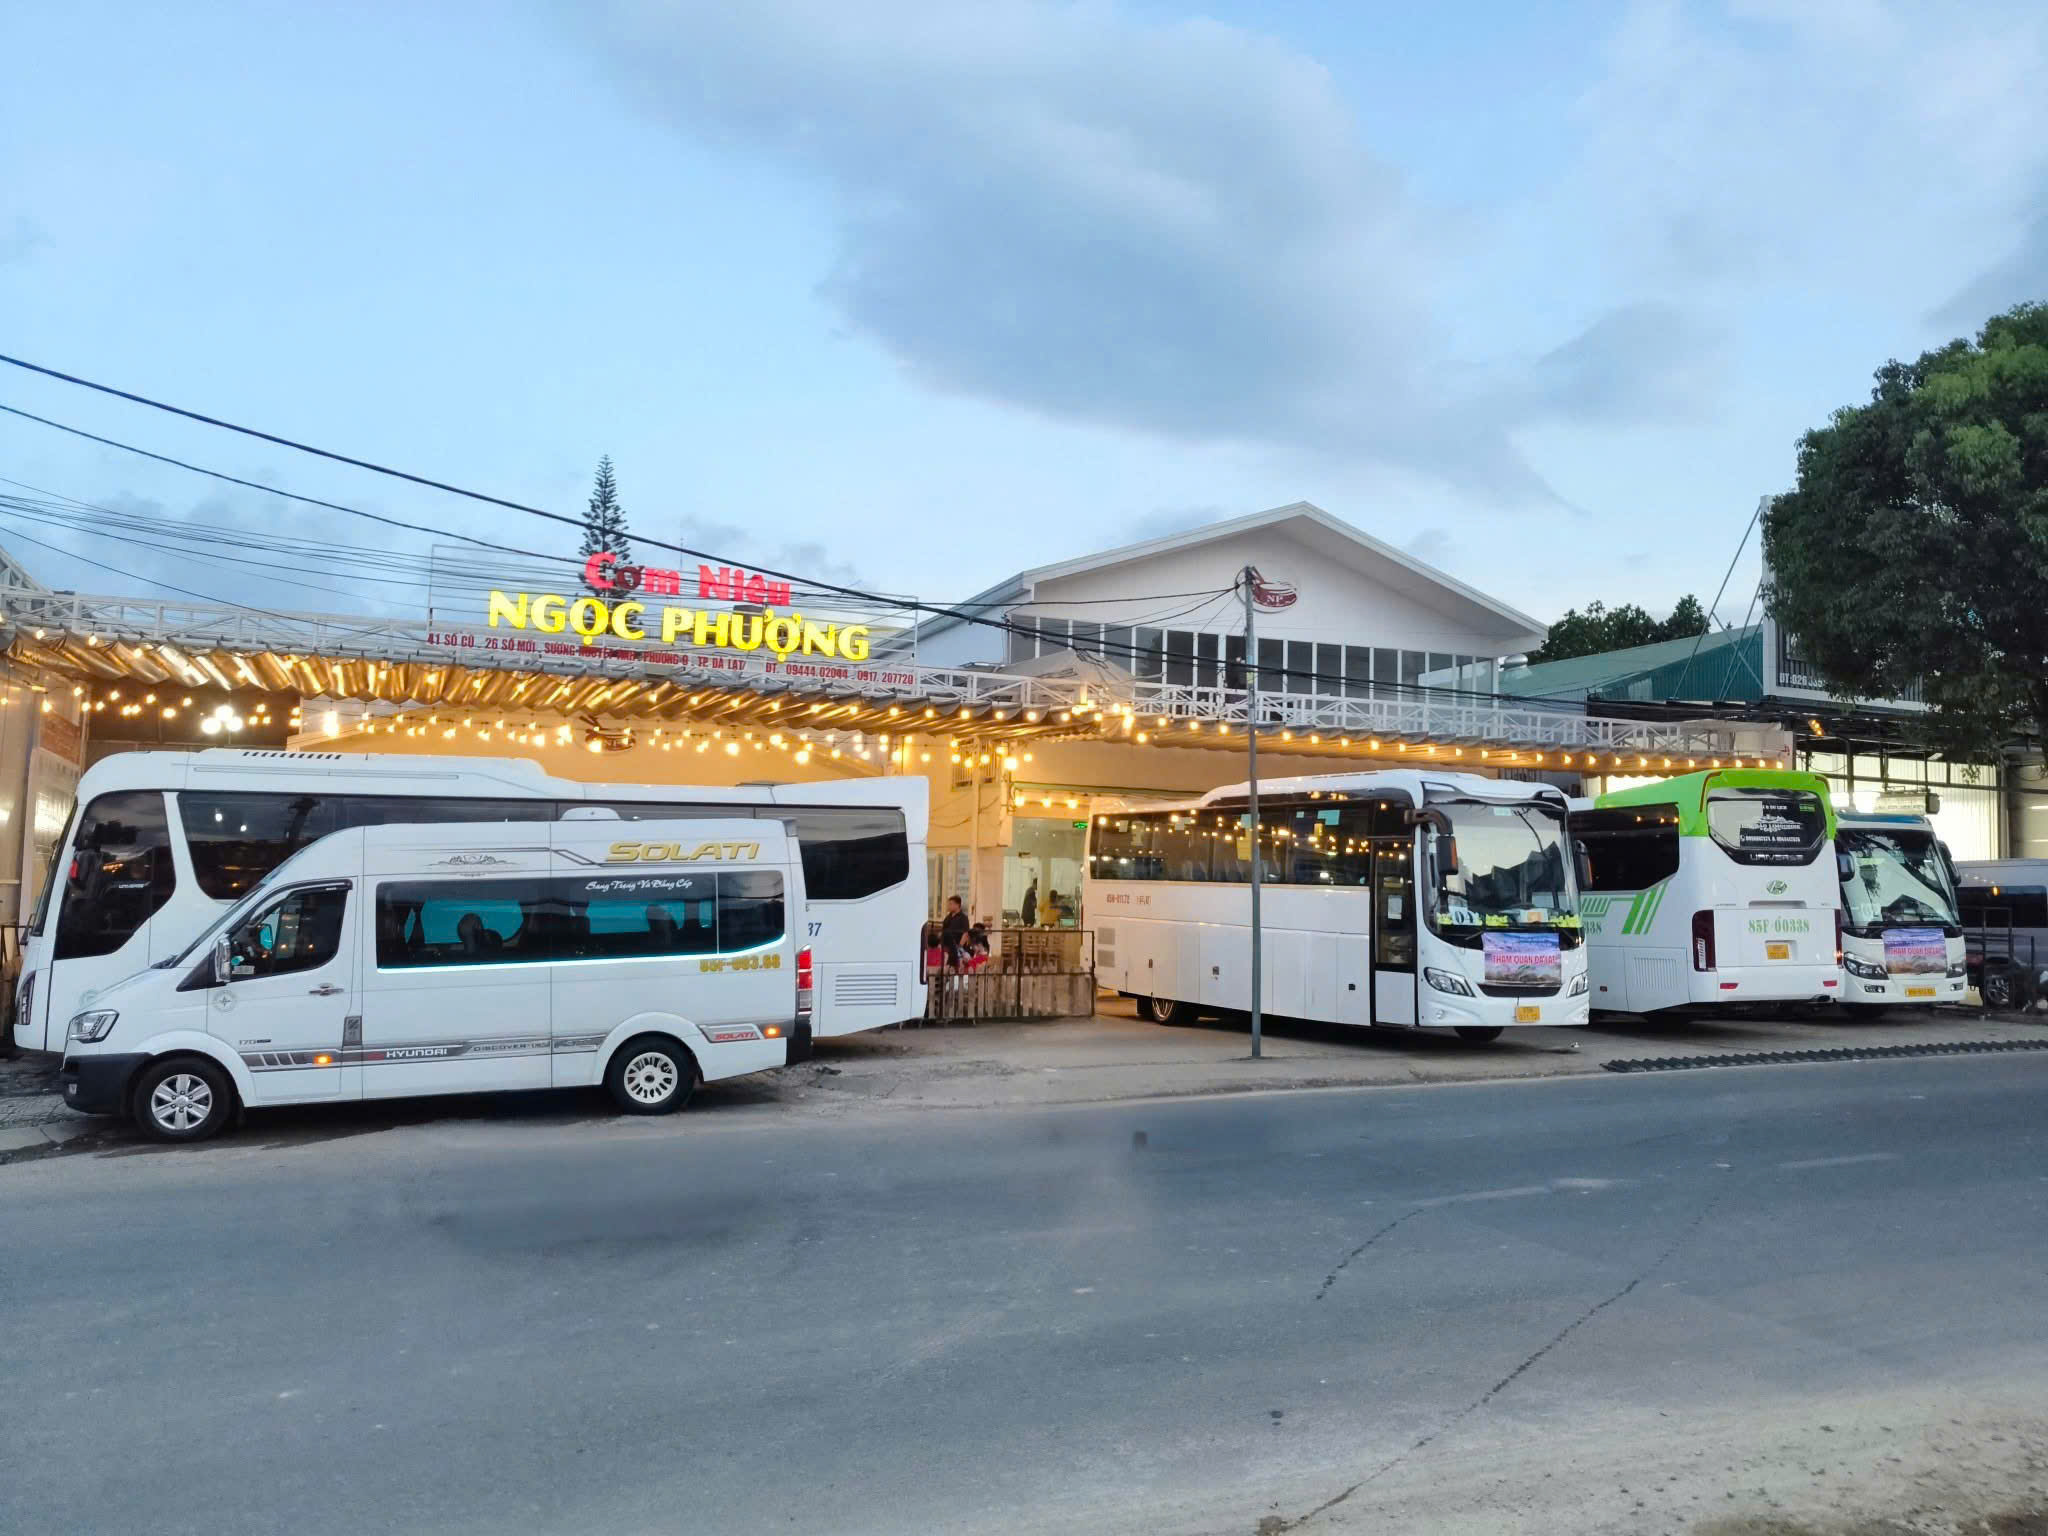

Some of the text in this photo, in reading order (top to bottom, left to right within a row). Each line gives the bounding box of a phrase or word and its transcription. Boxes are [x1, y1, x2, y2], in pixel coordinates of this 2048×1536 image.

[584, 551, 791, 606] Cơm Niêu
[488, 589, 870, 662] NGỌC PHƯỢNG
[427, 632, 440, 645] 41
[485, 637, 498, 650] 26
[605, 841, 760, 863] SOLATI
[386, 1048, 447, 1059] HYUNDAI
